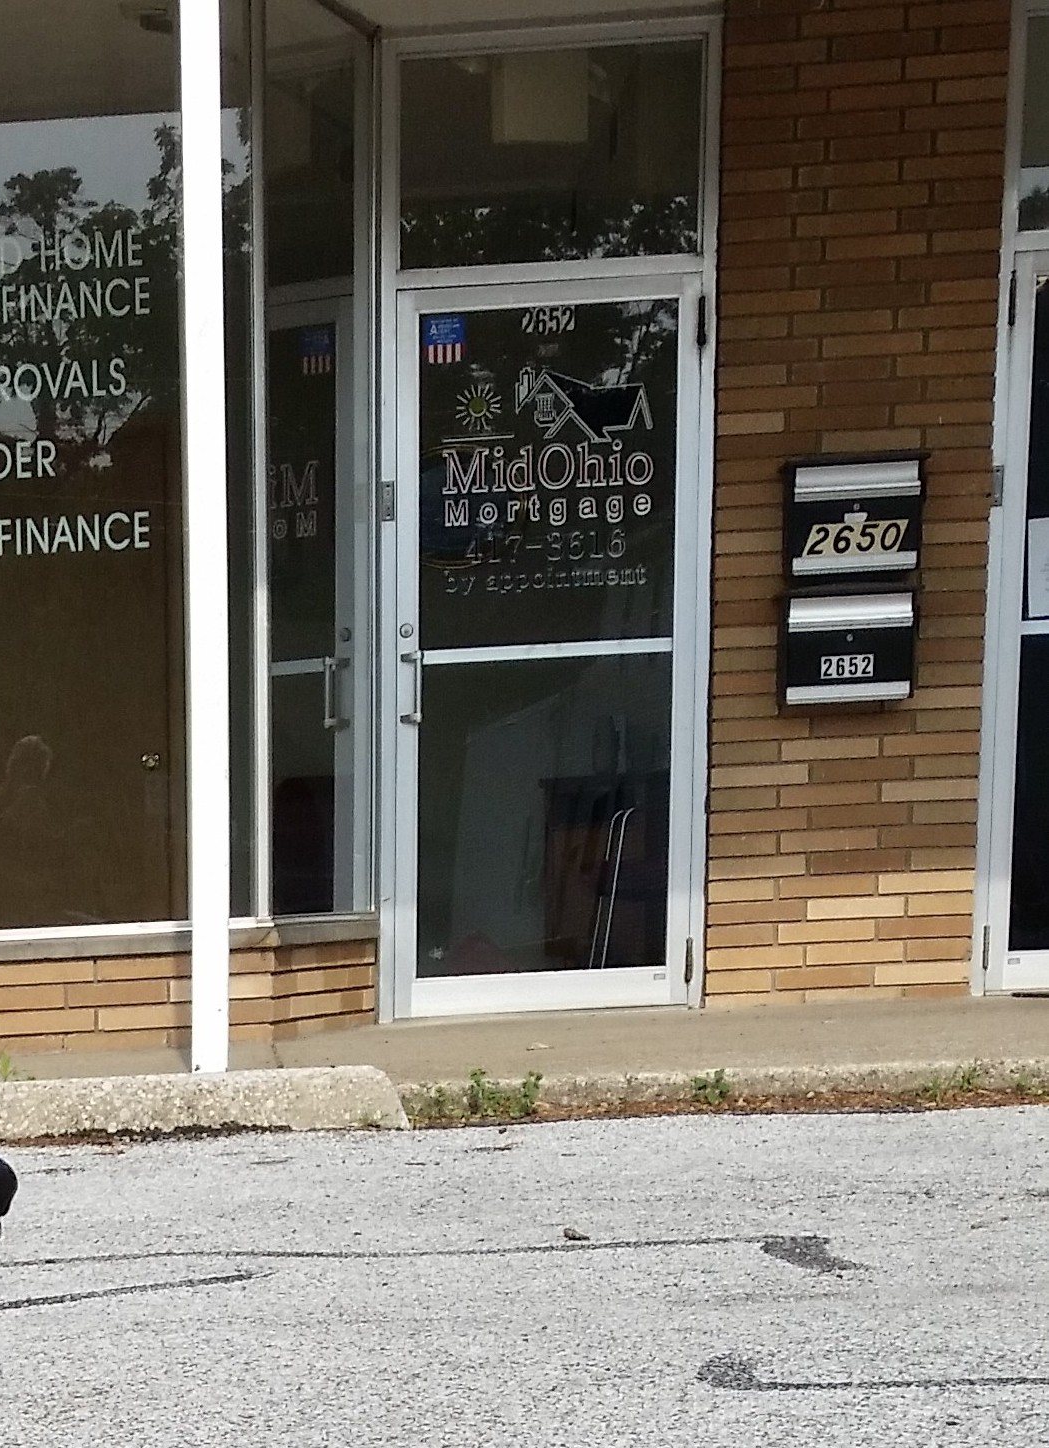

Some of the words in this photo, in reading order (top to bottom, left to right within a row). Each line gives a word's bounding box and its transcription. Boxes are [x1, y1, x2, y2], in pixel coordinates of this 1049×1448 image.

[39, 230, 143, 273] HOME
[521, 306, 575, 335] 2652
[442, 439, 654, 495] MidOhio
[444, 492, 651, 526] Mortgage
[806, 522, 901, 555] 2650
[444, 569, 475, 595] by
[487, 564, 647, 593] appointment
[823, 656, 871, 677] 2652
